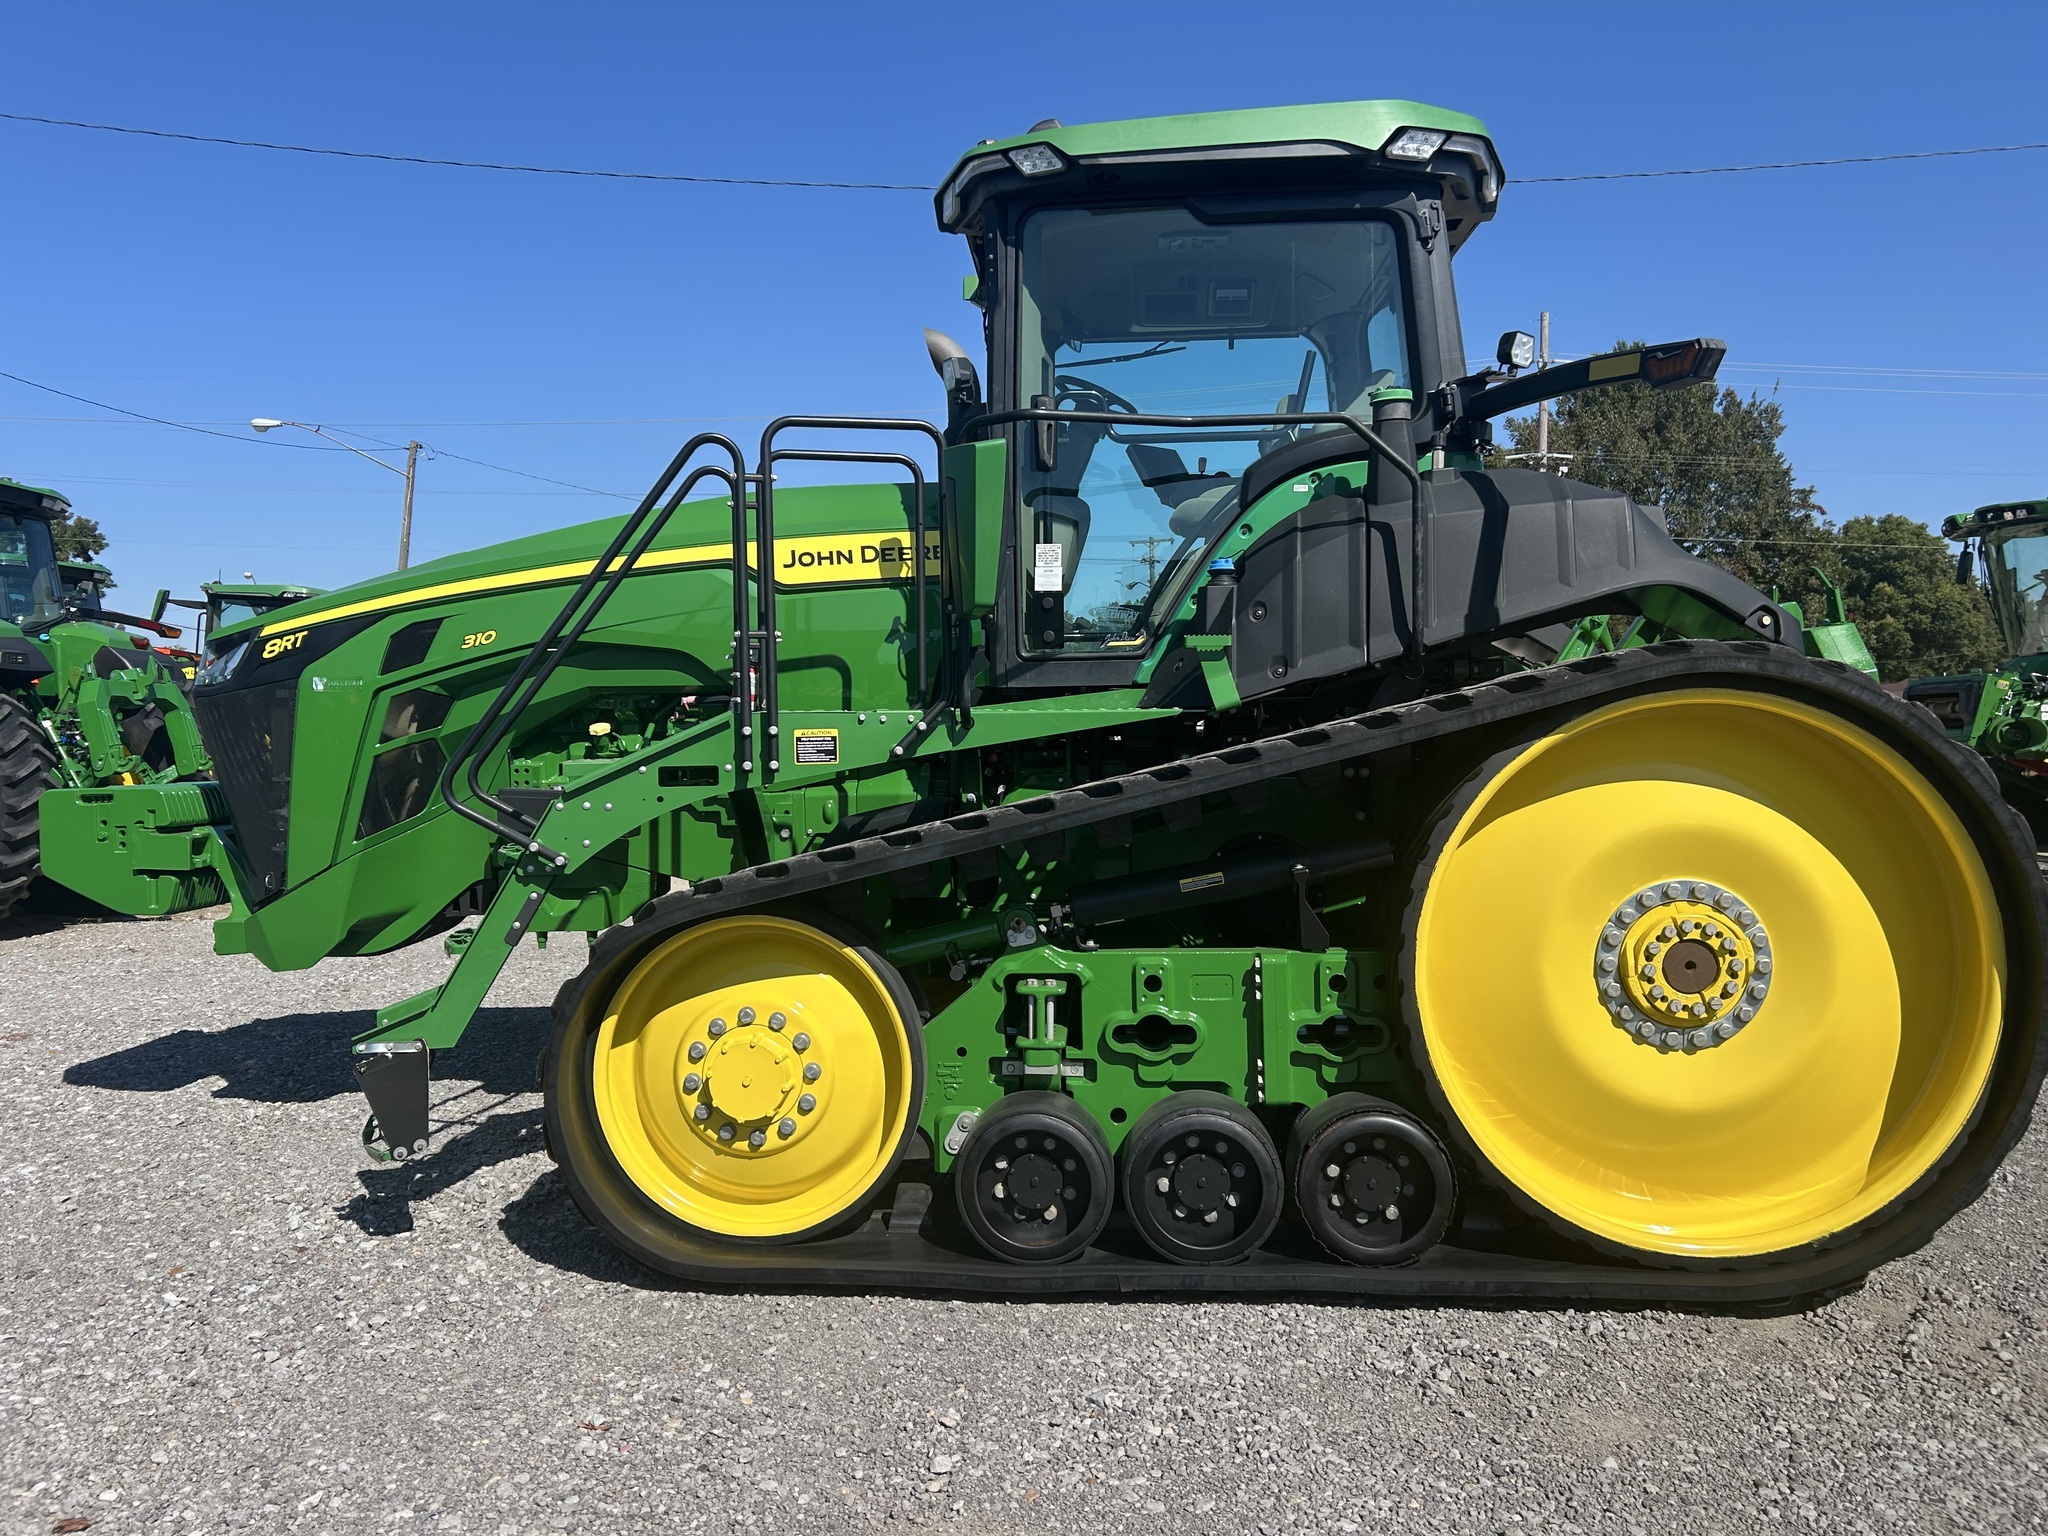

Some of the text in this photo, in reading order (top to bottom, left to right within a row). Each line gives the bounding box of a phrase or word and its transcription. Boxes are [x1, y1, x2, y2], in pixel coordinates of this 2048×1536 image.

[783, 549, 854, 569] JOHN
[262, 630, 309, 659] 8RT
[460, 630, 497, 649] 310
